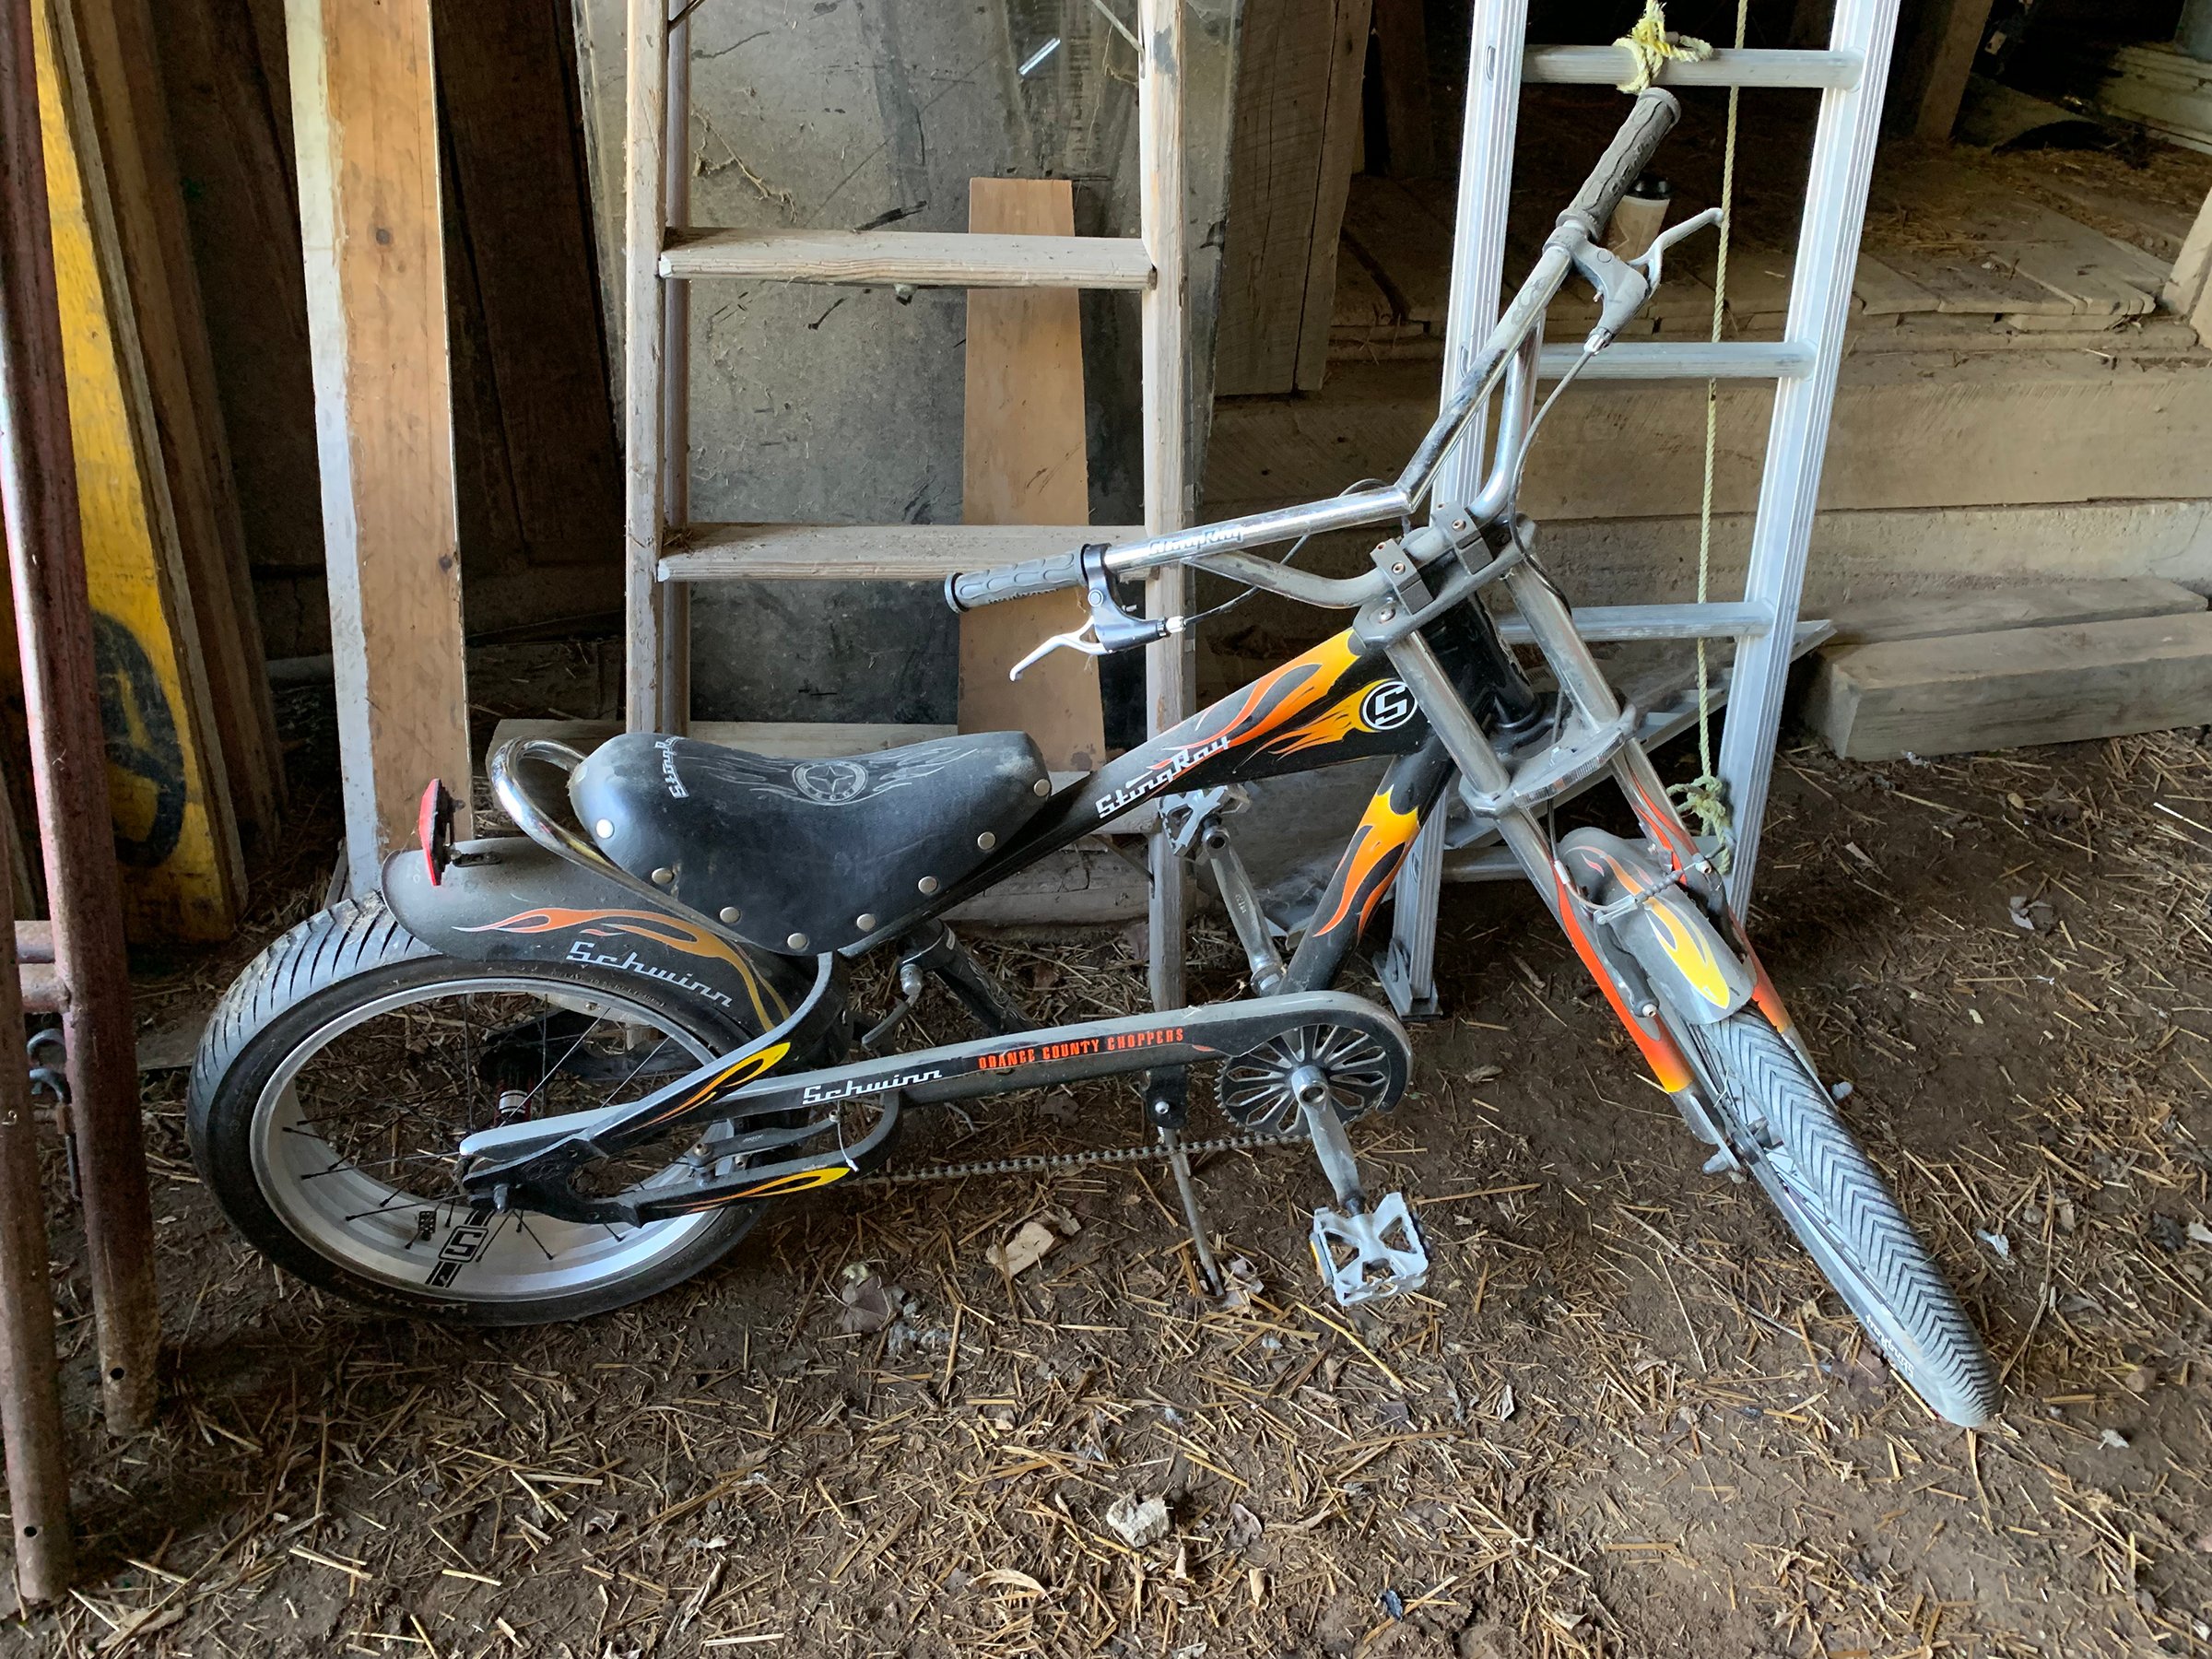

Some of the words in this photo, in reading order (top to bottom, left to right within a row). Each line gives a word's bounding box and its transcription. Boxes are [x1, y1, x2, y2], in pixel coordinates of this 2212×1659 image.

[1374, 685, 1407, 726] S
[653, 735, 689, 800] StingRa
[1095, 735, 1230, 819] StingRay
[566, 940, 733, 1008] Schwinn
[978, 1048, 1036, 1070] ORANGE
[1041, 1039, 1100, 1060] COUNTY
[1107, 1028, 1184, 1052] CHOPPERS
[802, 1068, 943, 1105] Schwinn
